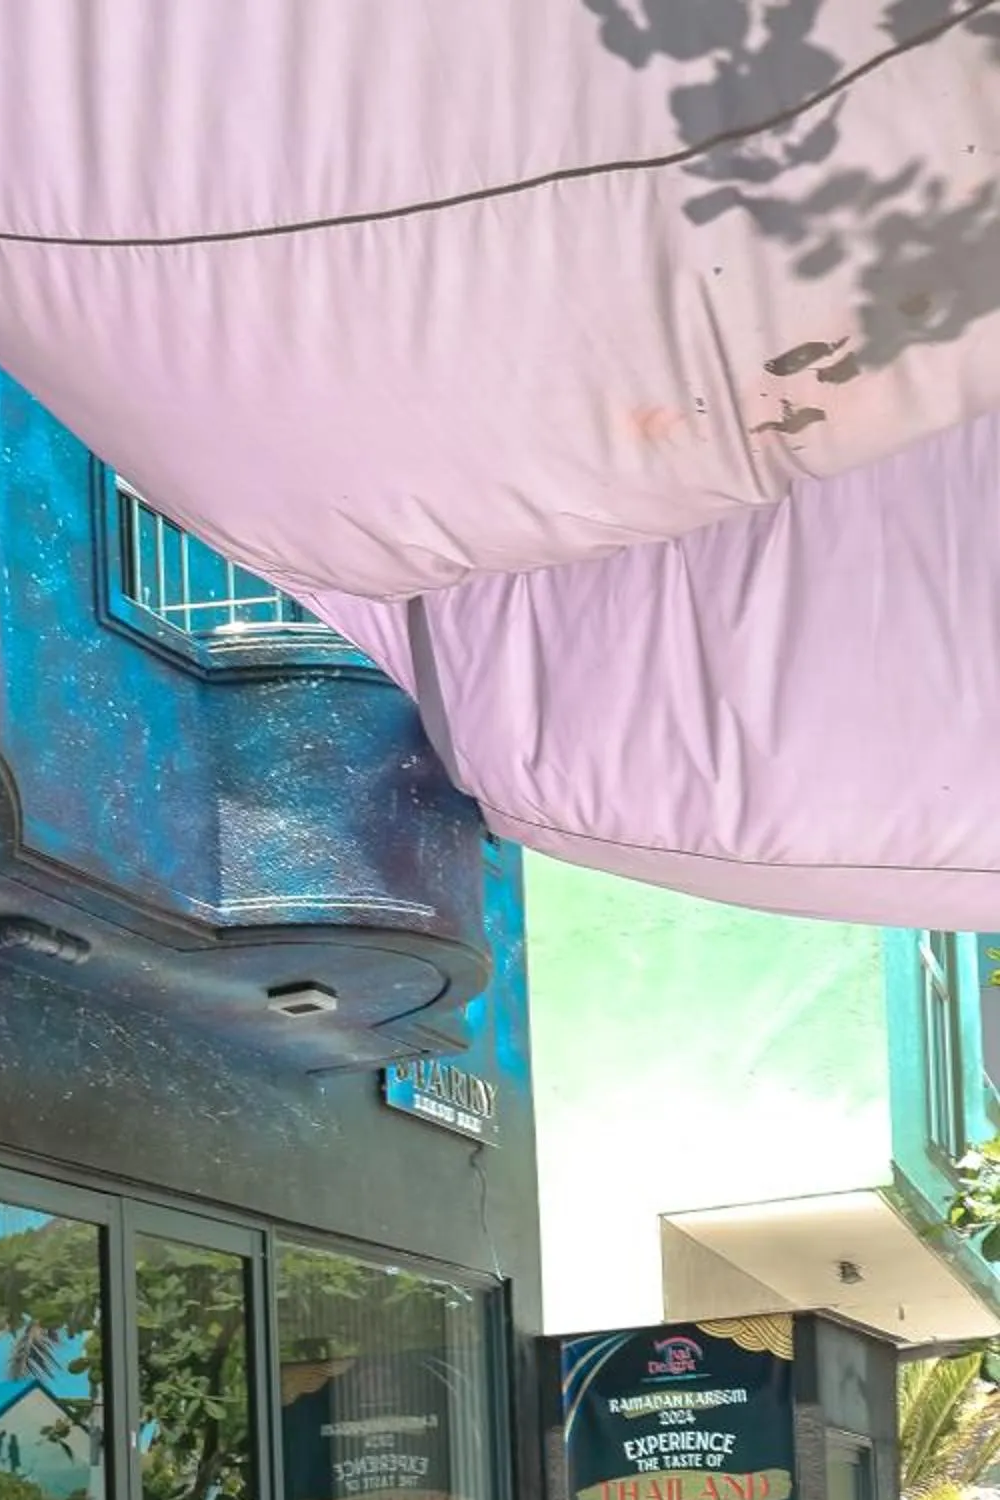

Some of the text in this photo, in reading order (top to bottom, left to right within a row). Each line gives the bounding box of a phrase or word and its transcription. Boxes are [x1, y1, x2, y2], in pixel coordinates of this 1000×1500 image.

[608, 1394, 682, 1413] RAMADAN
[623, 1431, 737, 1460] EXPERIENCE
[636, 1453, 725, 1472] THE TASTE OF
